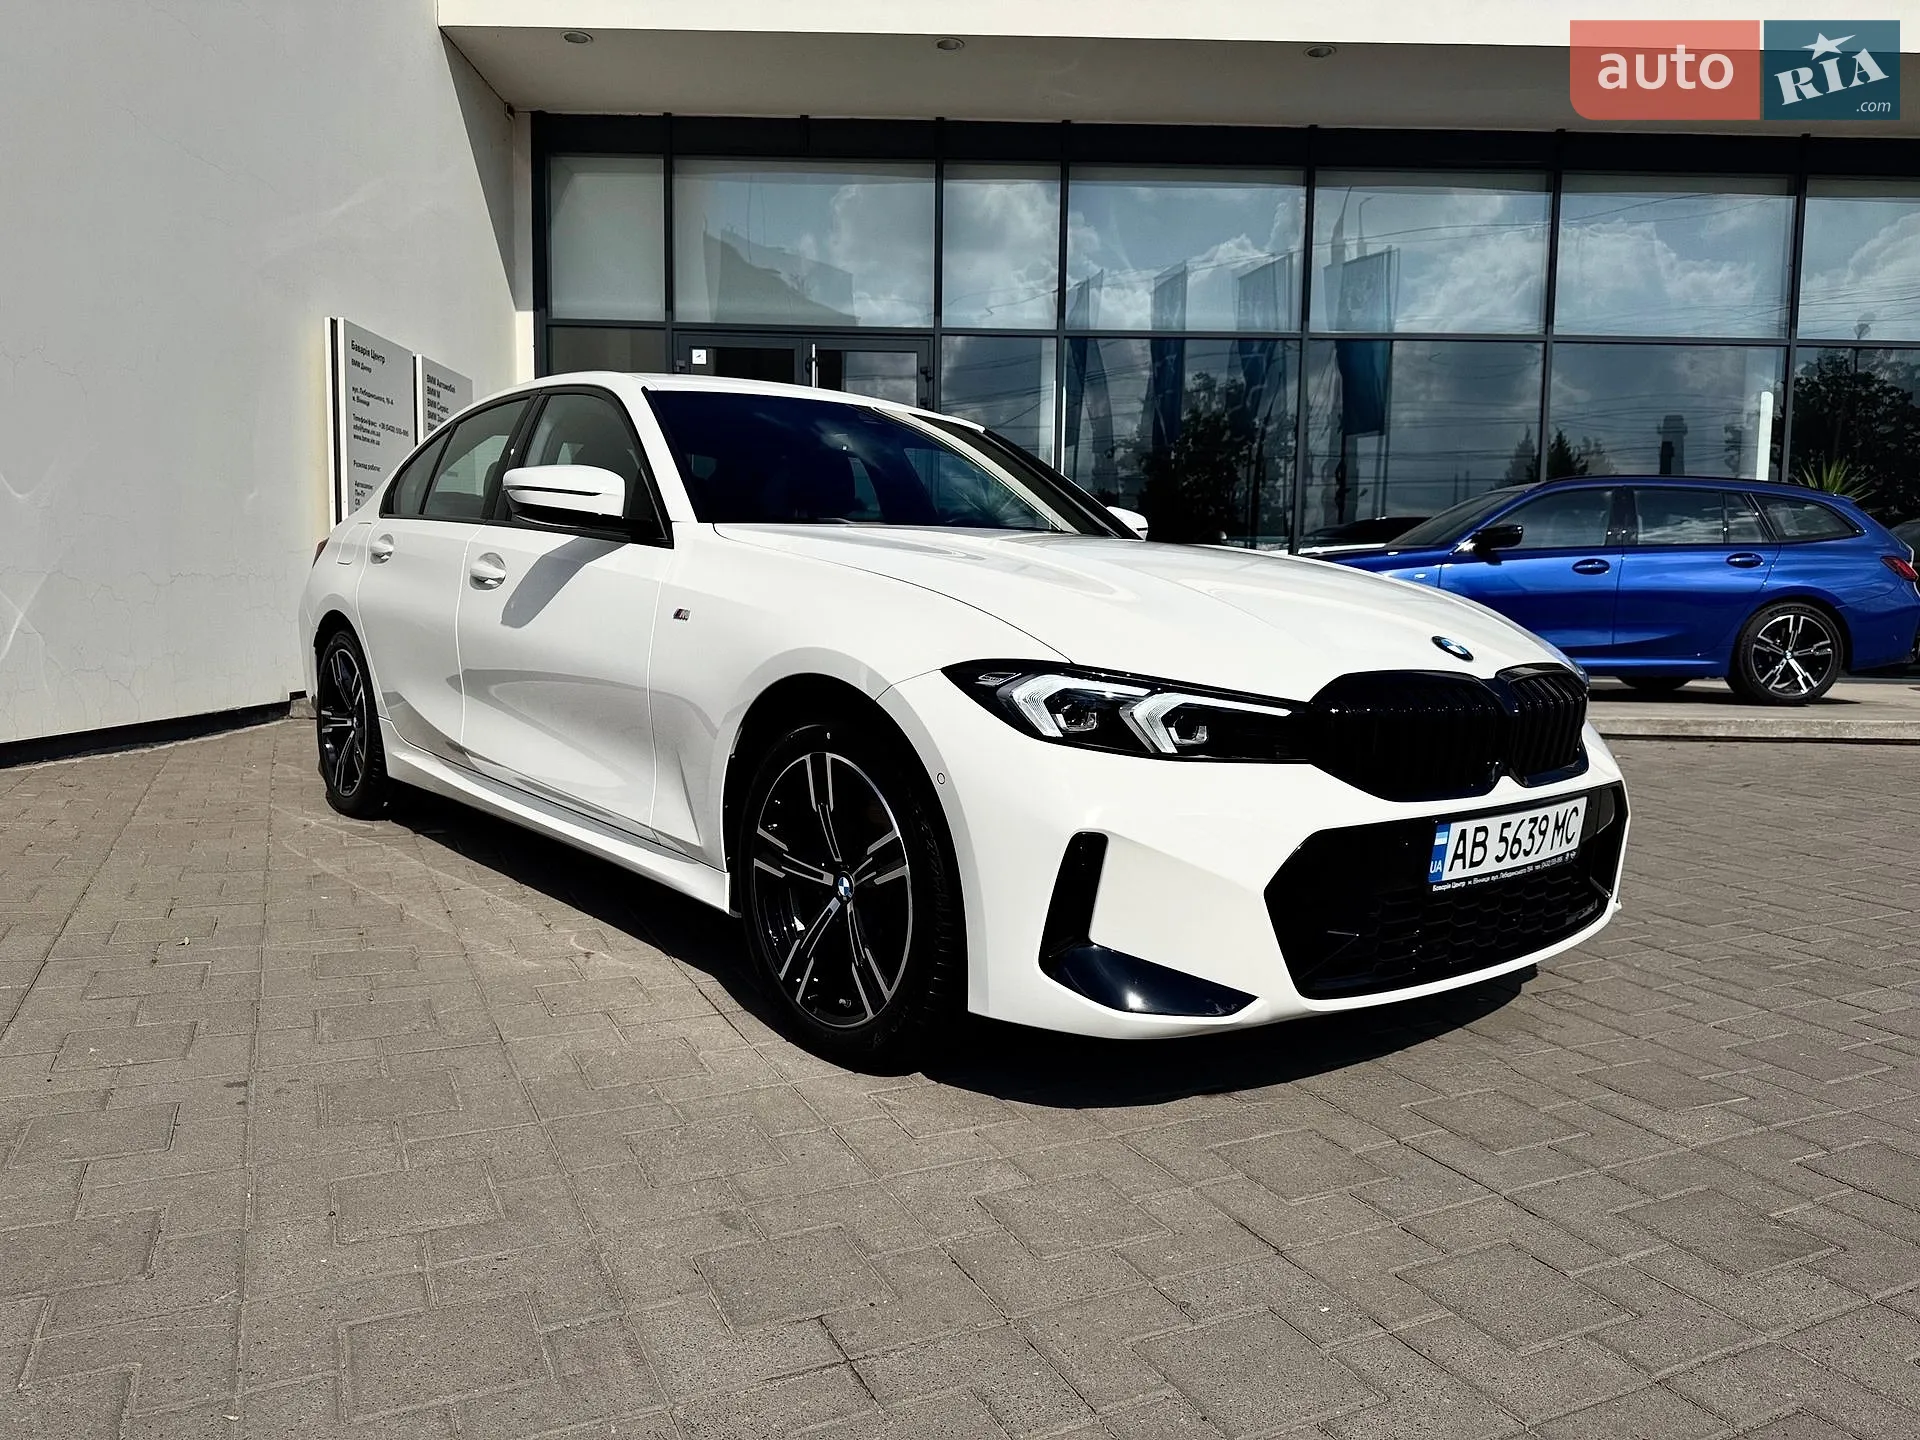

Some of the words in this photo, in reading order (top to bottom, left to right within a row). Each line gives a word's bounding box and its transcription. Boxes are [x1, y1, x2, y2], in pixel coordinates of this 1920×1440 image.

[351, 340, 370, 357] Баварія
[371, 349, 386, 365] Центр
[426, 374, 436, 386] BMW
[427, 386, 437, 397] BMW
[427, 398, 437, 408] BMW
[427, 410, 437, 420] BMW
[1448, 825, 1489, 873] AB
[1494, 814, 1549, 863] 5639
[1550, 806, 1579, 851] MC
[1430, 859, 1442, 874] UA
